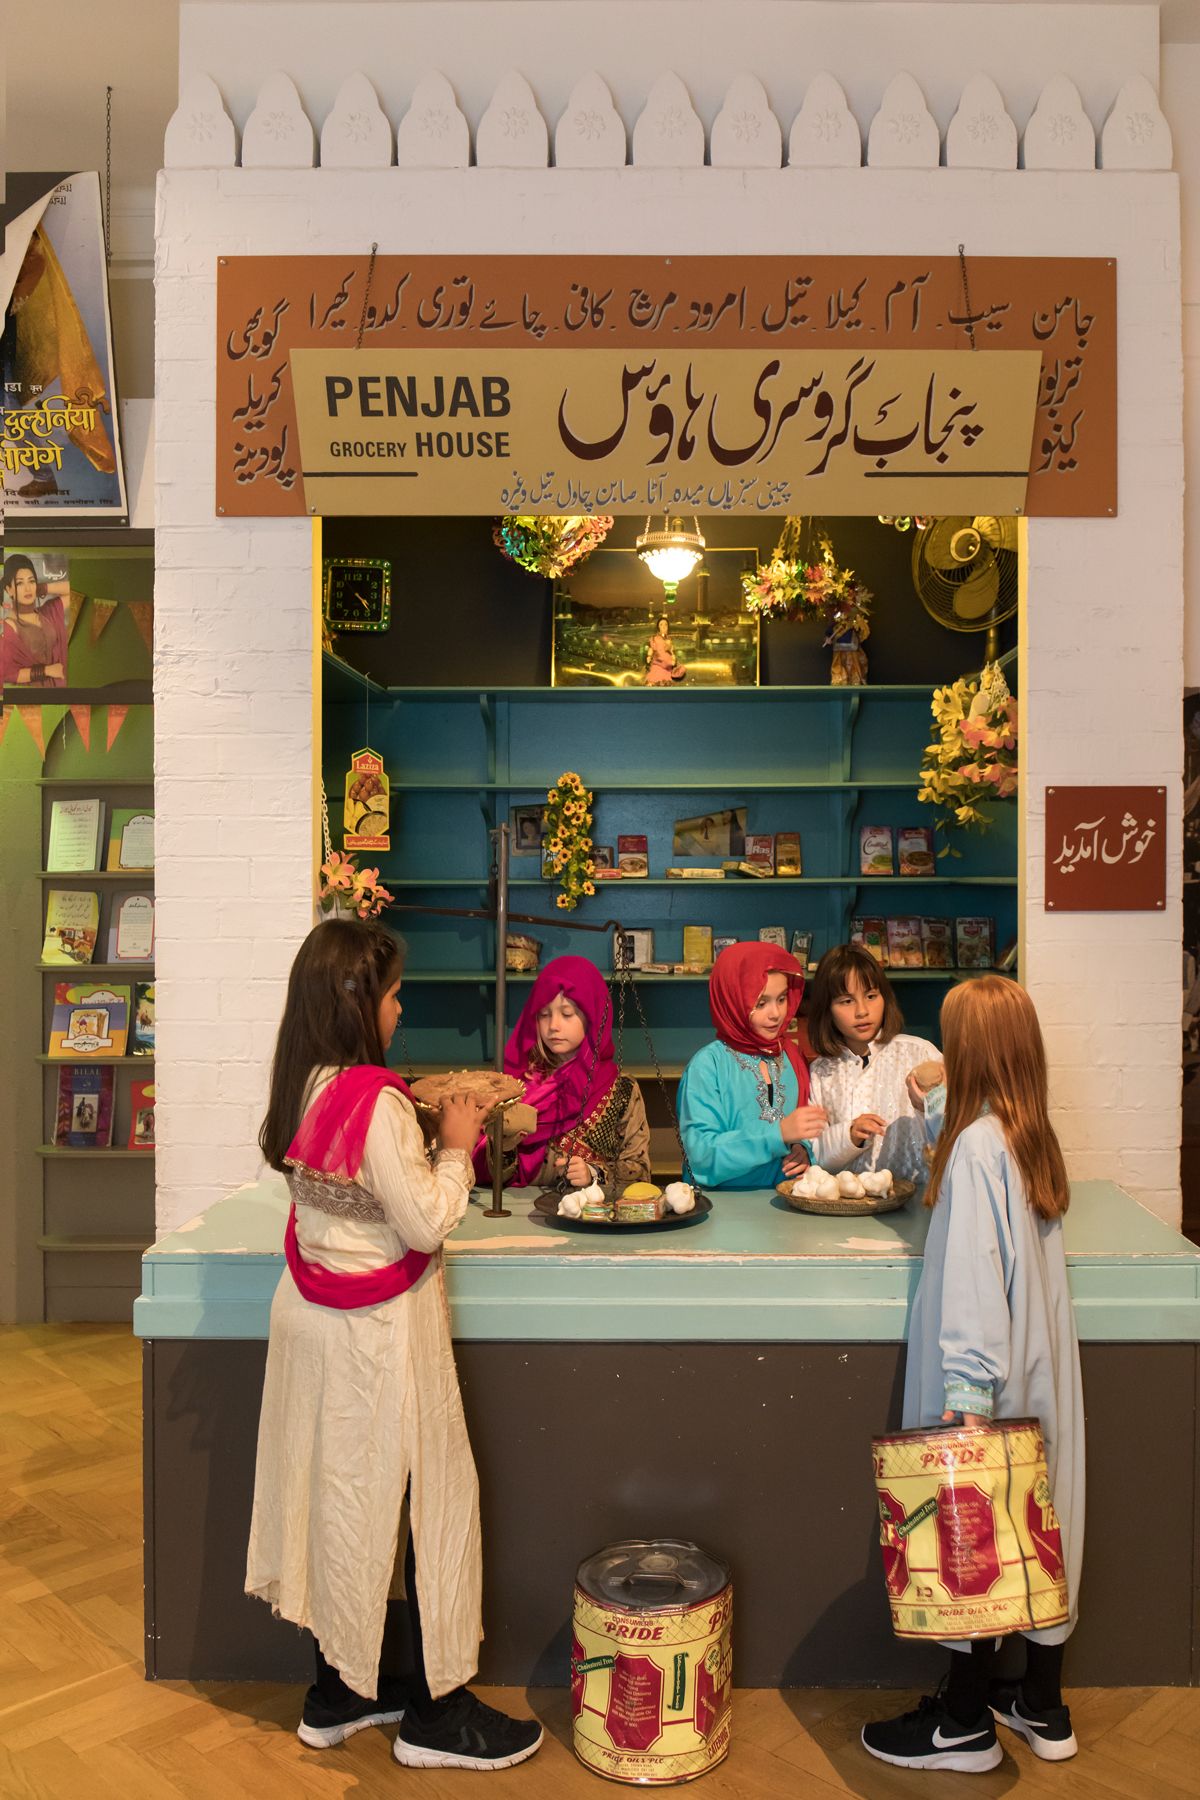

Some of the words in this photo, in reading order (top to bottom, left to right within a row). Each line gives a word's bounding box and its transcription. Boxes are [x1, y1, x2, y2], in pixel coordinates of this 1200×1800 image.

[363, 271, 411, 331] کدو
[417, 275, 476, 331] توری
[564, 282, 615, 332] کافی
[628, 286, 678, 331] مرچ
[688, 285, 748, 332] امرود
[761, 274, 814, 333] تیل
[826, 276, 869, 331] کیلا
[885, 271, 932, 332] آم
[1032, 296, 1096, 348] جامن
[227, 297, 291, 361] گوبھی
[325, 375, 511, 418] PENJAB
[557, 357, 705, 467] ہاؤس
[706, 356, 877, 478] گروسری
[233, 424, 298, 491] پودینہ
[330, 441, 407, 458] GROCERY
[415, 431, 511, 458] HOUSE
[1035, 408, 1085, 474] کینو
[530, 471, 555, 504] تیل
[557, 478, 594, 513] چاول
[595, 478, 638, 505] صابن
[647, 471, 669, 506] آٹا
[673, 480, 705, 505] میدہ
[756, 478, 792, 511] چینی
[1052, 815, 1106, 875] آمدید
[1101, 811, 1156, 865] خوش
[604, 1621, 665, 1640] PRIDE
